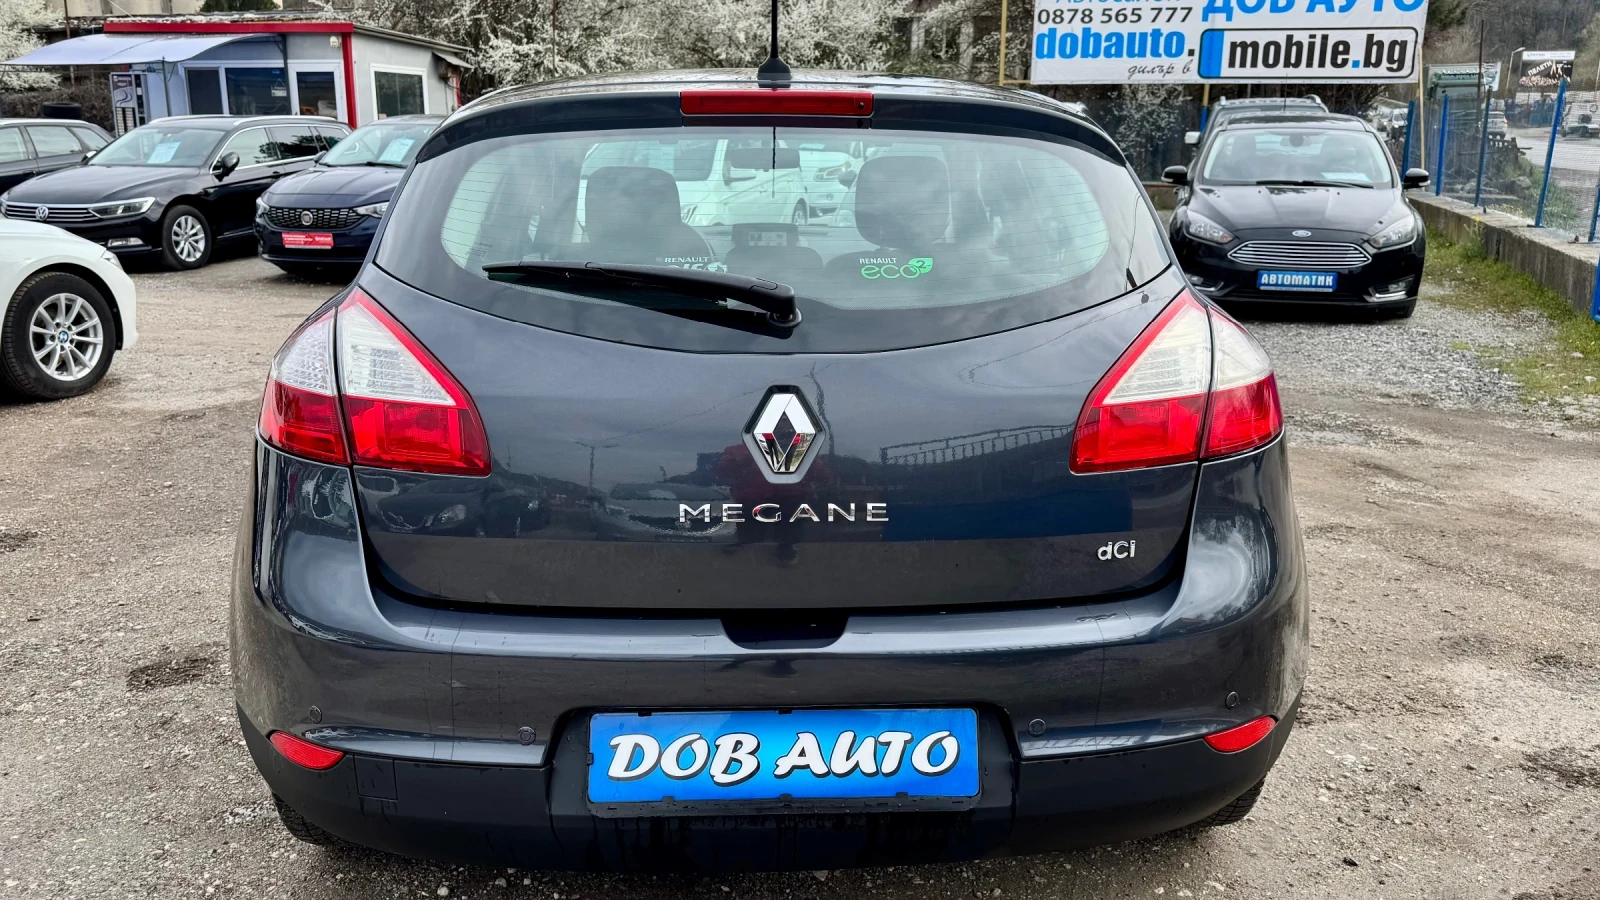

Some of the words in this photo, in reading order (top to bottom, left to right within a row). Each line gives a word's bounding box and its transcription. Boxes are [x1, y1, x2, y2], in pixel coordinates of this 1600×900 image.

[1037, 8, 1094, 25] 0878
[1100, 7, 1142, 24] 565
[1150, 6, 1194, 23] 777
[1228, 34, 1408, 73] mobile.bg
[1261, 273, 1334, 286] АВТОМАТИК
[679, 503, 889, 523] MEGANE
[1097, 540, 1136, 560] dCi
[607, 732, 761, 787] DOB
[774, 730, 960, 779] AUTO
